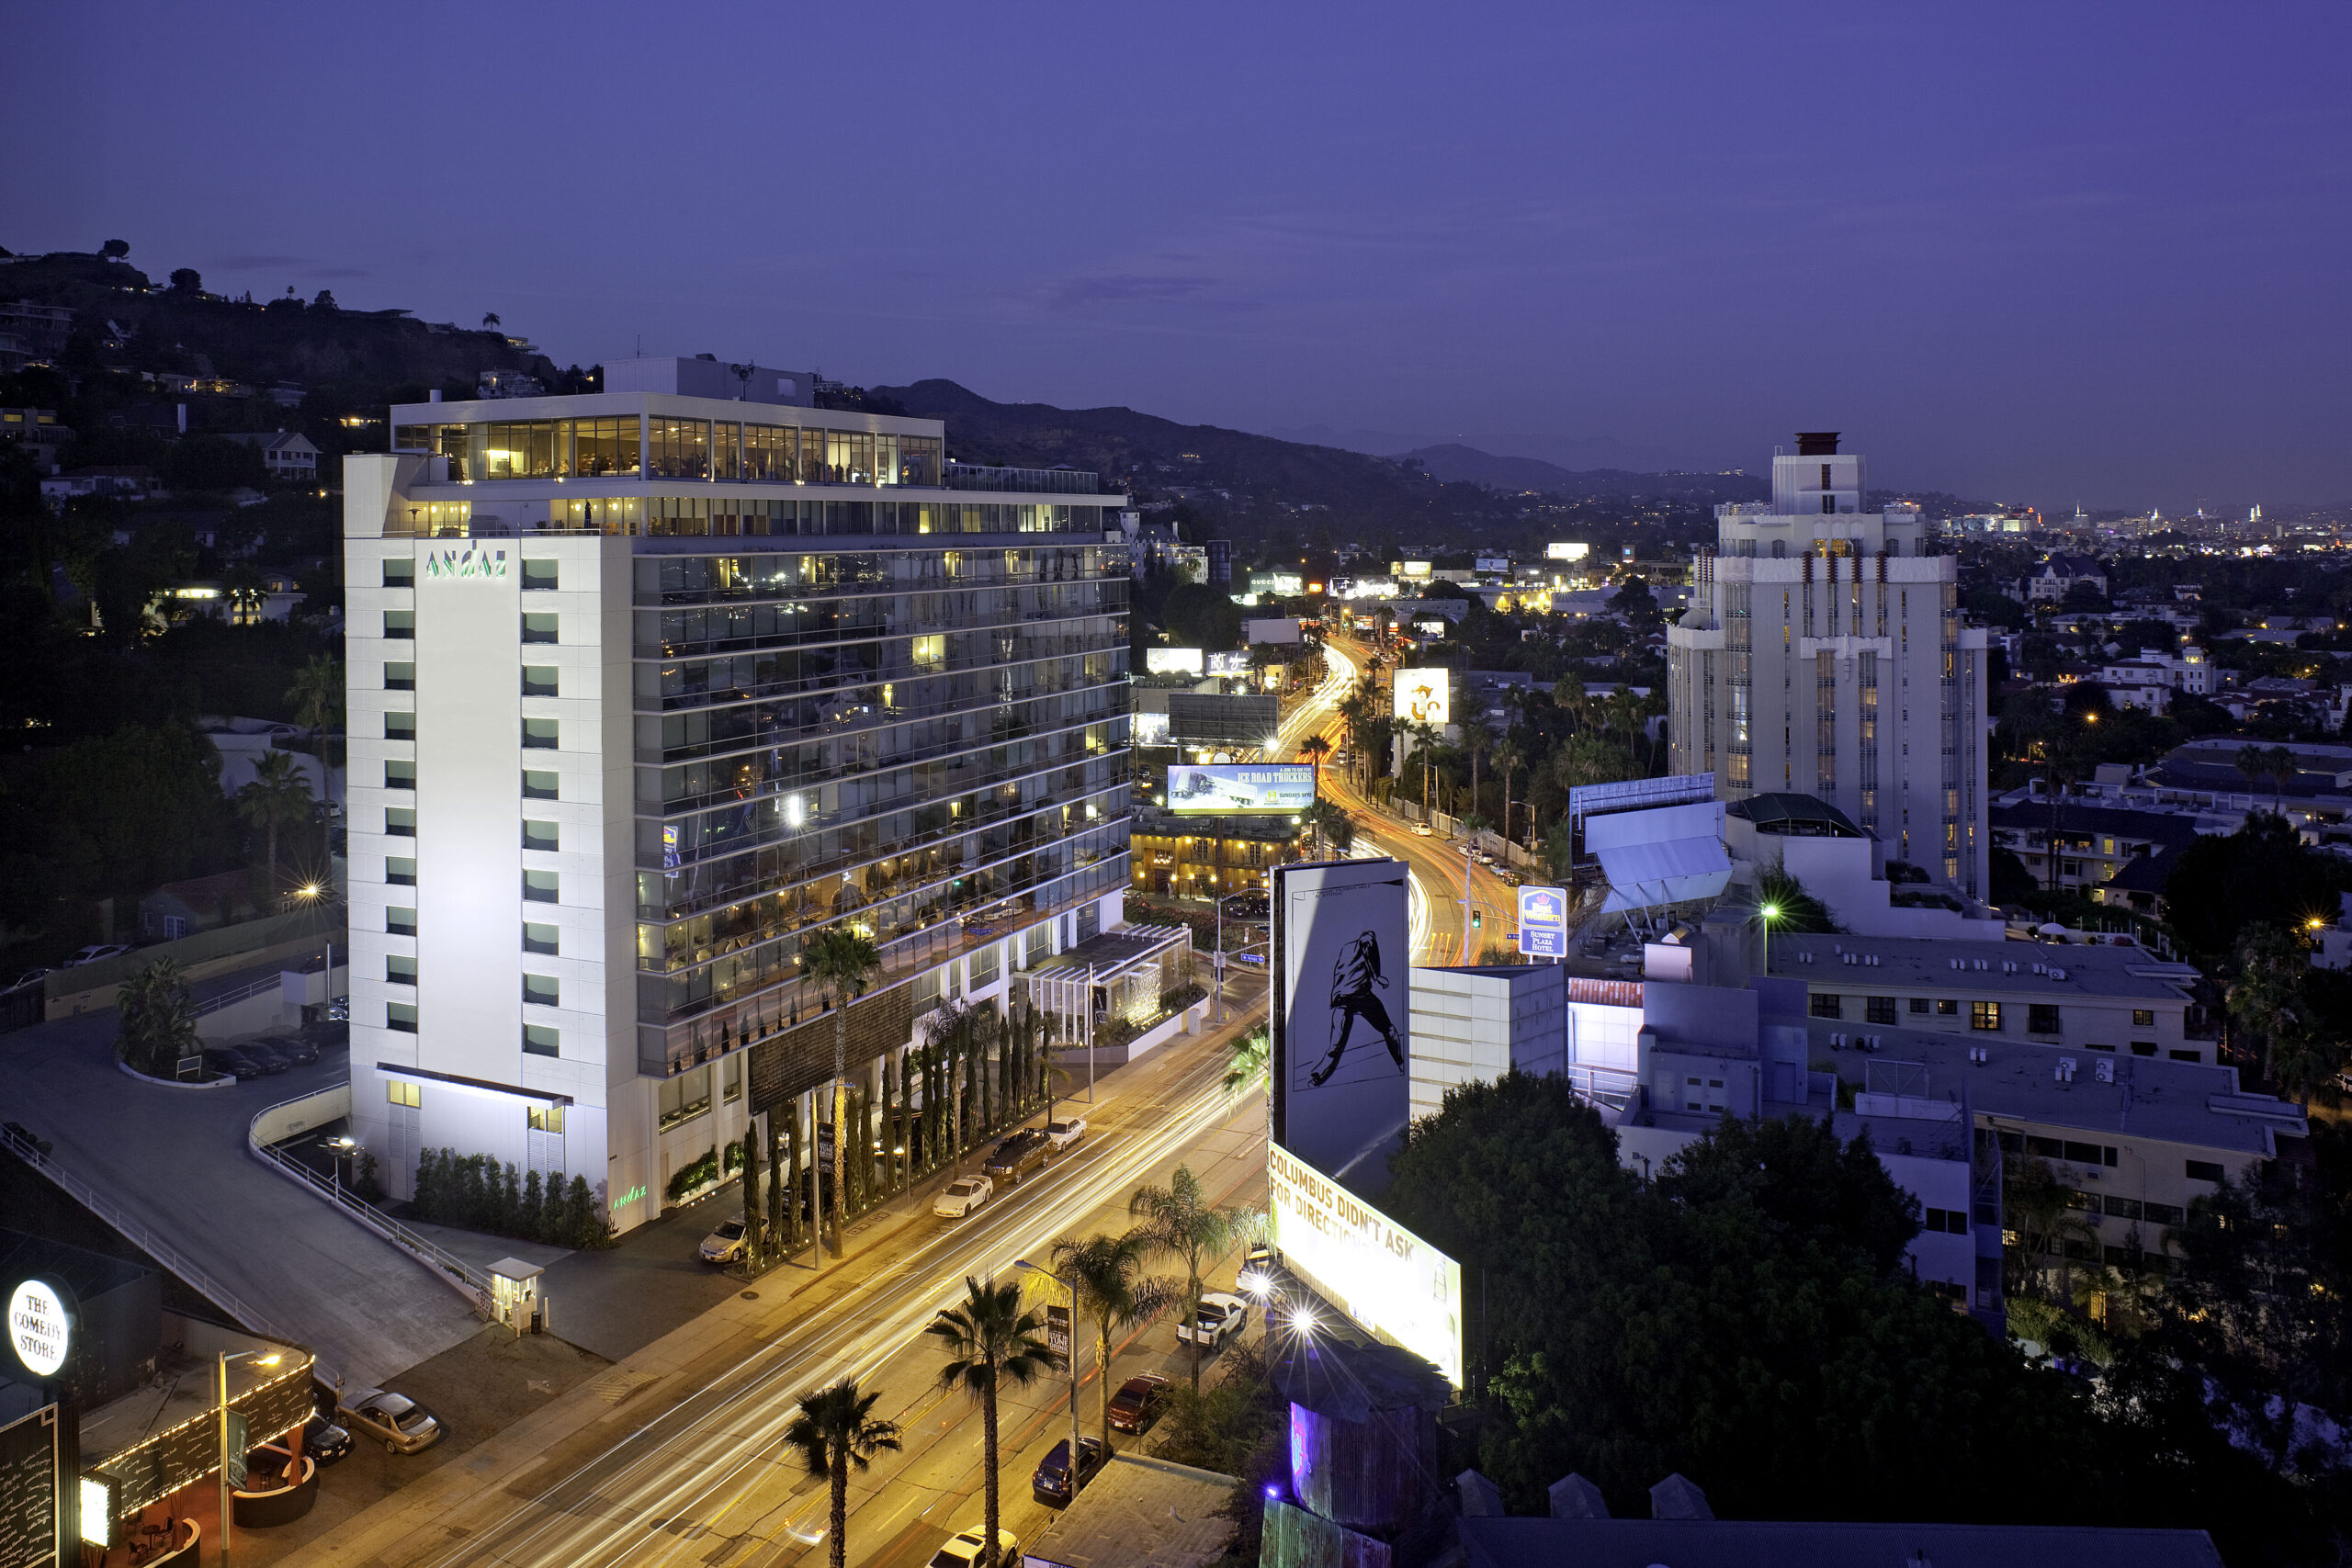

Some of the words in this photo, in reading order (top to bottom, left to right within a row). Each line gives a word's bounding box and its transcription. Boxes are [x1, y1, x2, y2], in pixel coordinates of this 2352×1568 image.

[1238, 773, 1250, 783] ICE
[1250, 773, 1272, 783] ROAD
[1272, 773, 1312, 783] TRUCKERS
[1532, 903, 1553, 914] Best
[1525, 909, 1561, 923] Western
[1531, 931, 1555, 940] SUNSET
[1532, 937, 1553, 946] PLAZA
[1532, 944, 1555, 953] HOTEL
[1271, 1176, 1291, 1209] FOR
[1270, 1150, 1333, 1209] COLUMBUS
[1338, 1194, 1382, 1243] DIDN'T
[1385, 1228, 1414, 1262] ASK
[27, 1295, 50, 1316] THE
[15, 1312, 62, 1341] COMEDY
[21, 1335, 57, 1361] STORE
